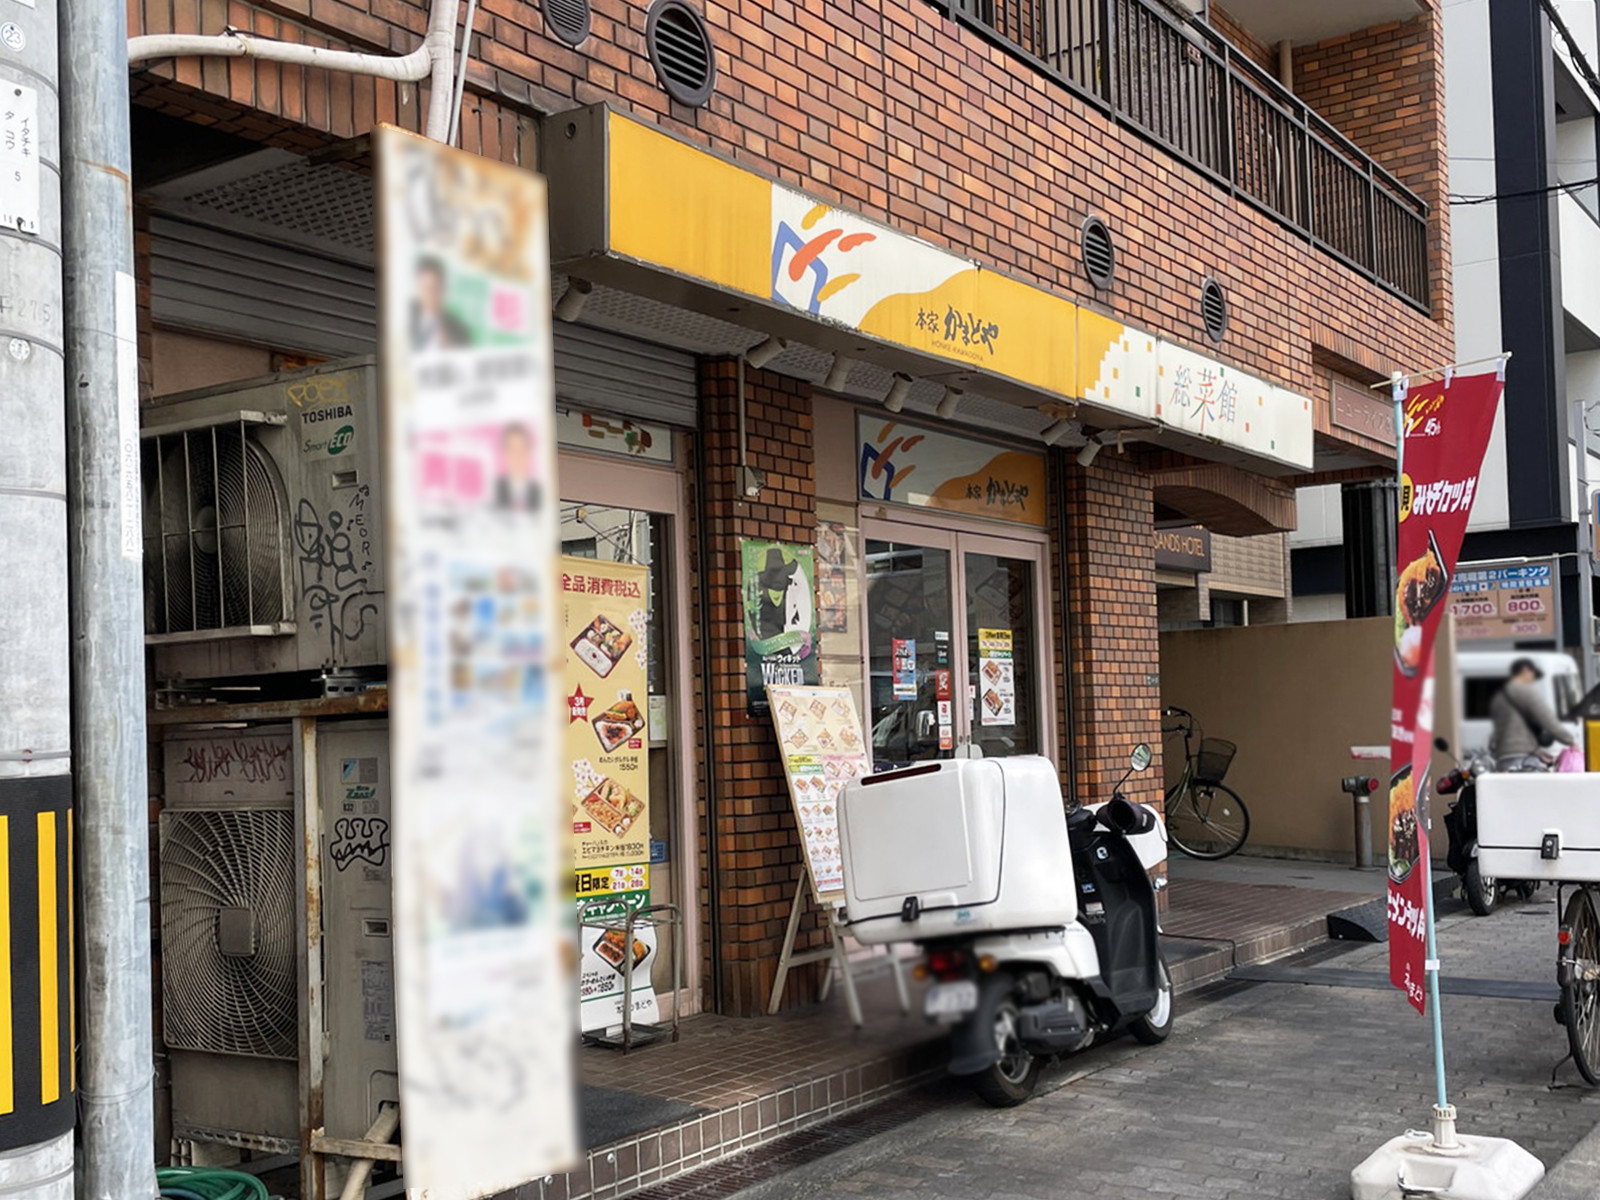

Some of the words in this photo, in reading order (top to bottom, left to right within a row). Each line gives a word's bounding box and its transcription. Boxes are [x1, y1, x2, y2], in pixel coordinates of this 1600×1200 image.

[302, 405, 353, 424] TOSHIBA
[562, 573, 641, 599] 全品消費税込
